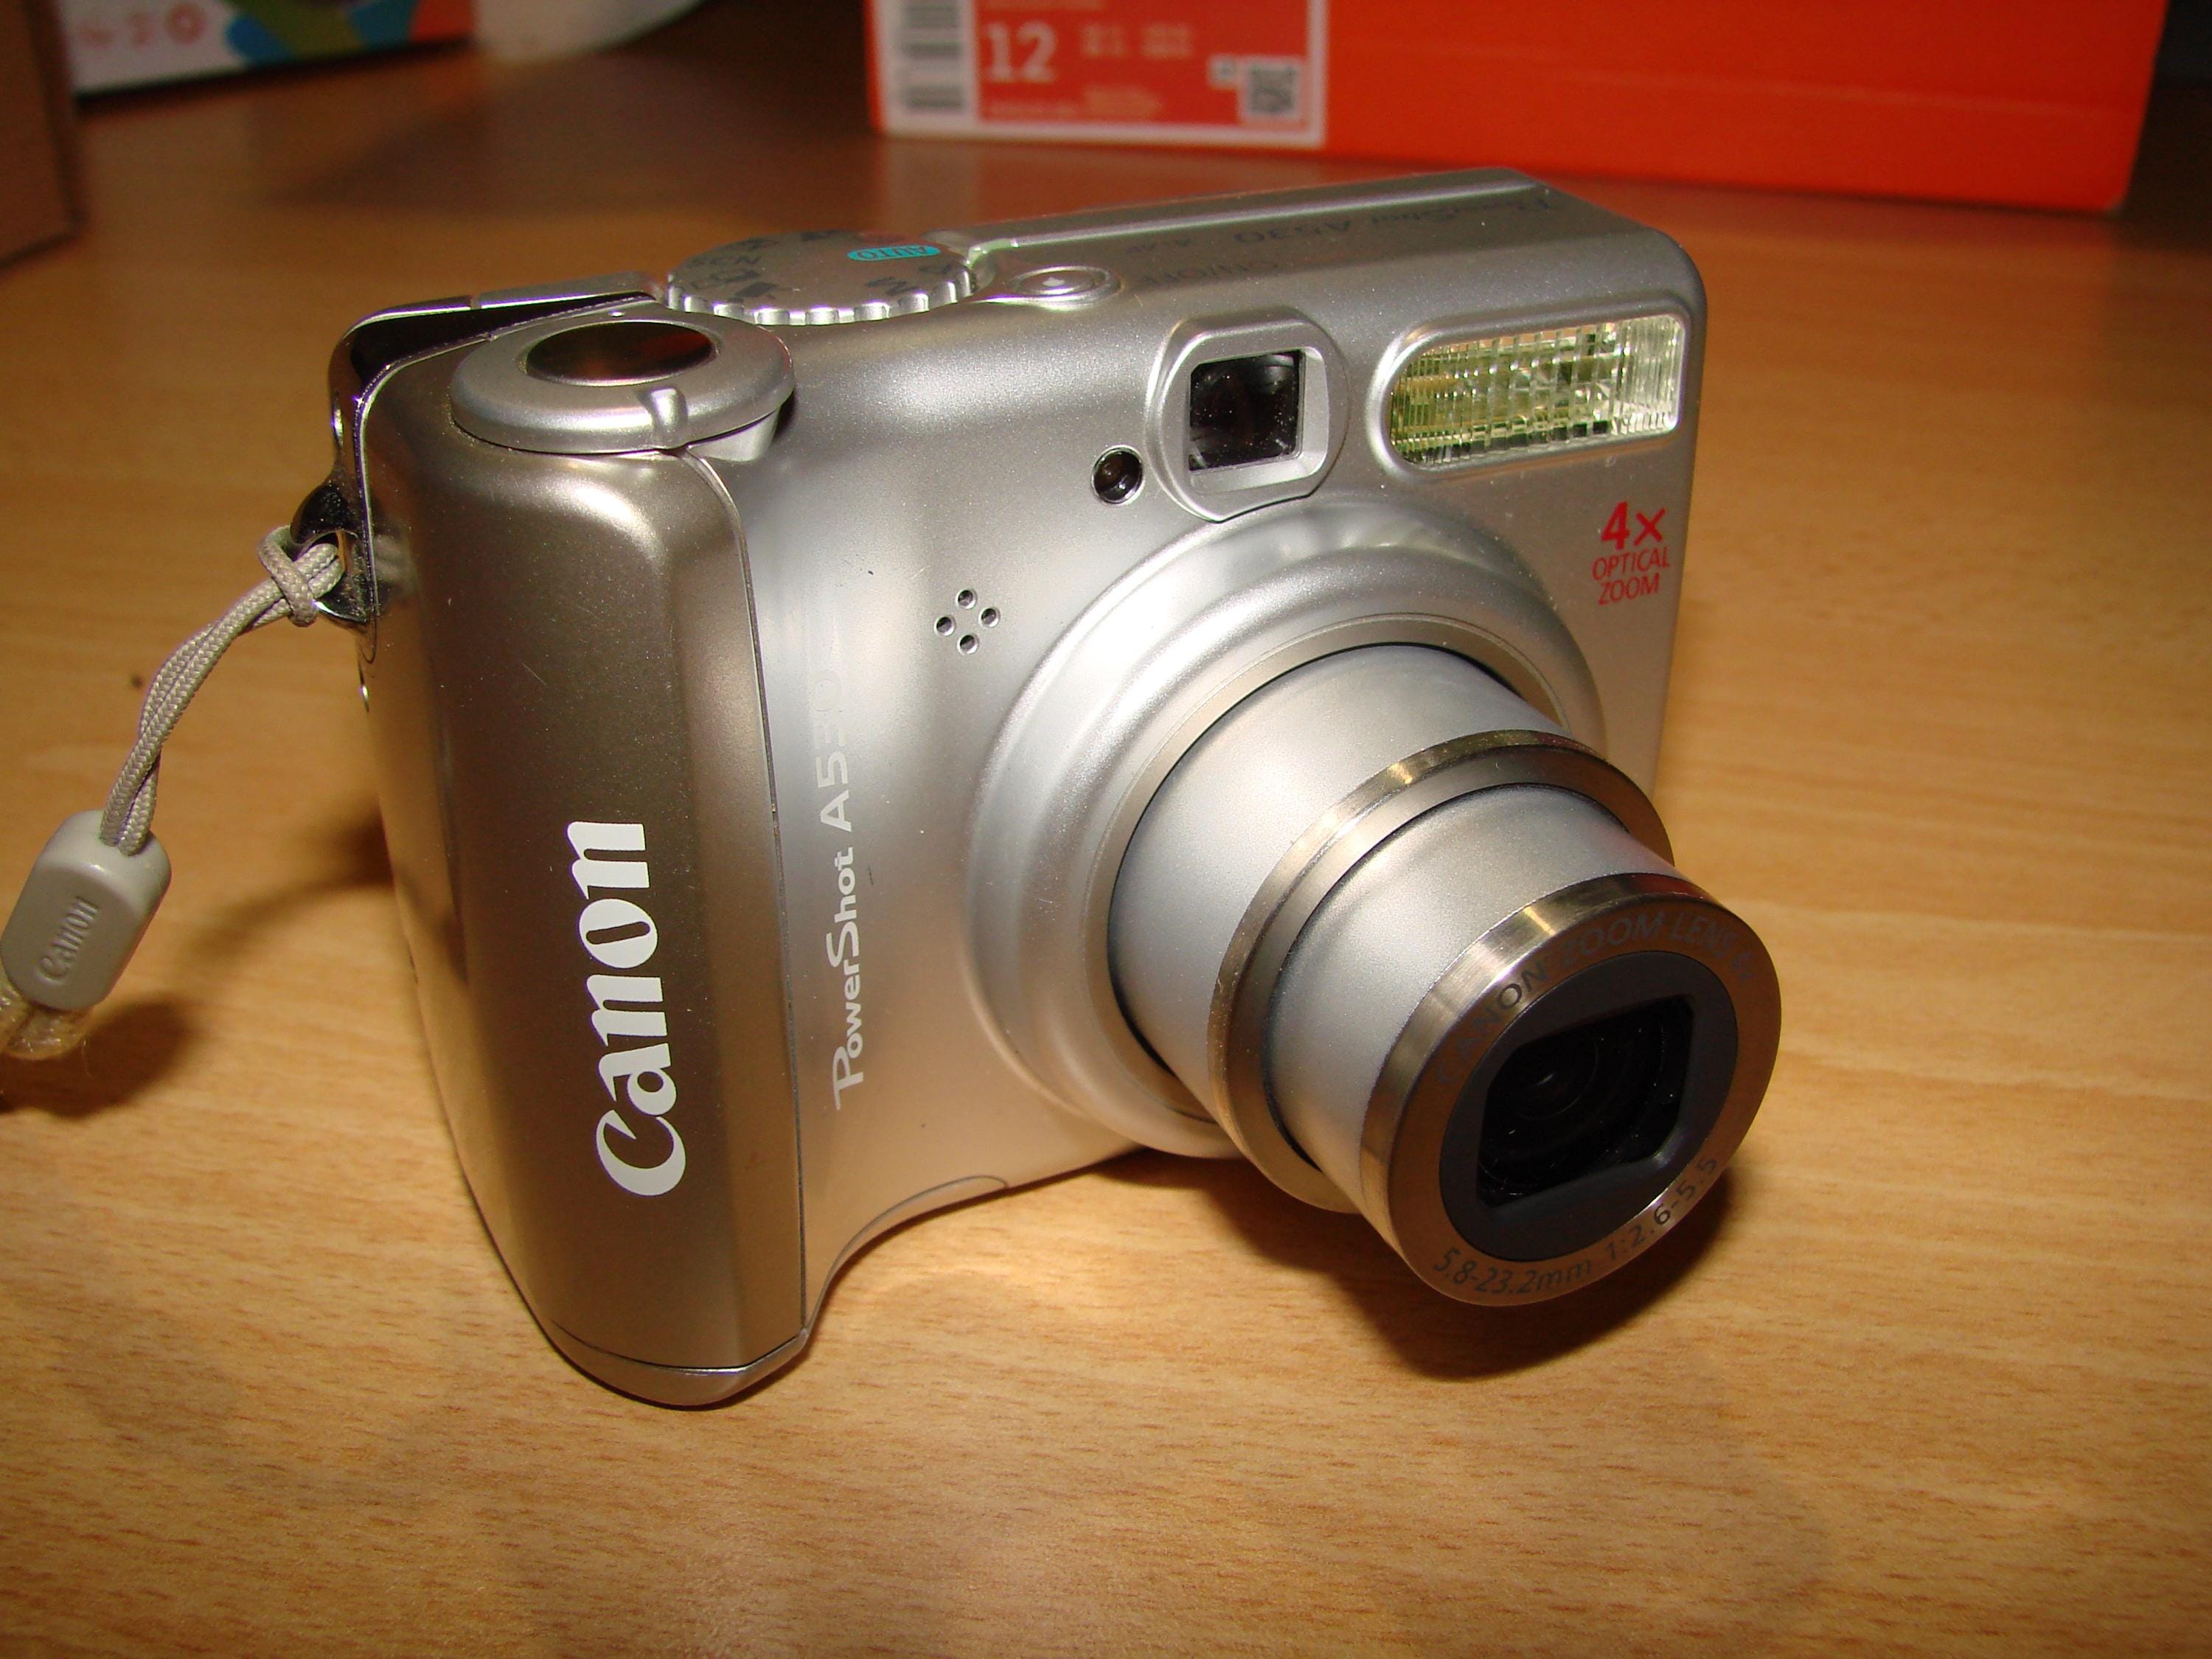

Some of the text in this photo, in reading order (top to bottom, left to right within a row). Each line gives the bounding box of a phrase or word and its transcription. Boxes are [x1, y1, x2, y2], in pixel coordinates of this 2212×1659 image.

[984, 20, 1058, 83] 12
[854, 247, 930, 260] AUTO
[1591, 546, 1670, 581] OPTICAL
[1598, 572, 1660, 606] ZOOM
[36, 896, 99, 987] Canon
[826, 846, 866, 1111] PowerShot
[566, 820, 686, 1196] Canon
[1433, 1246, 1593, 1295] 5.8-23.2mm
